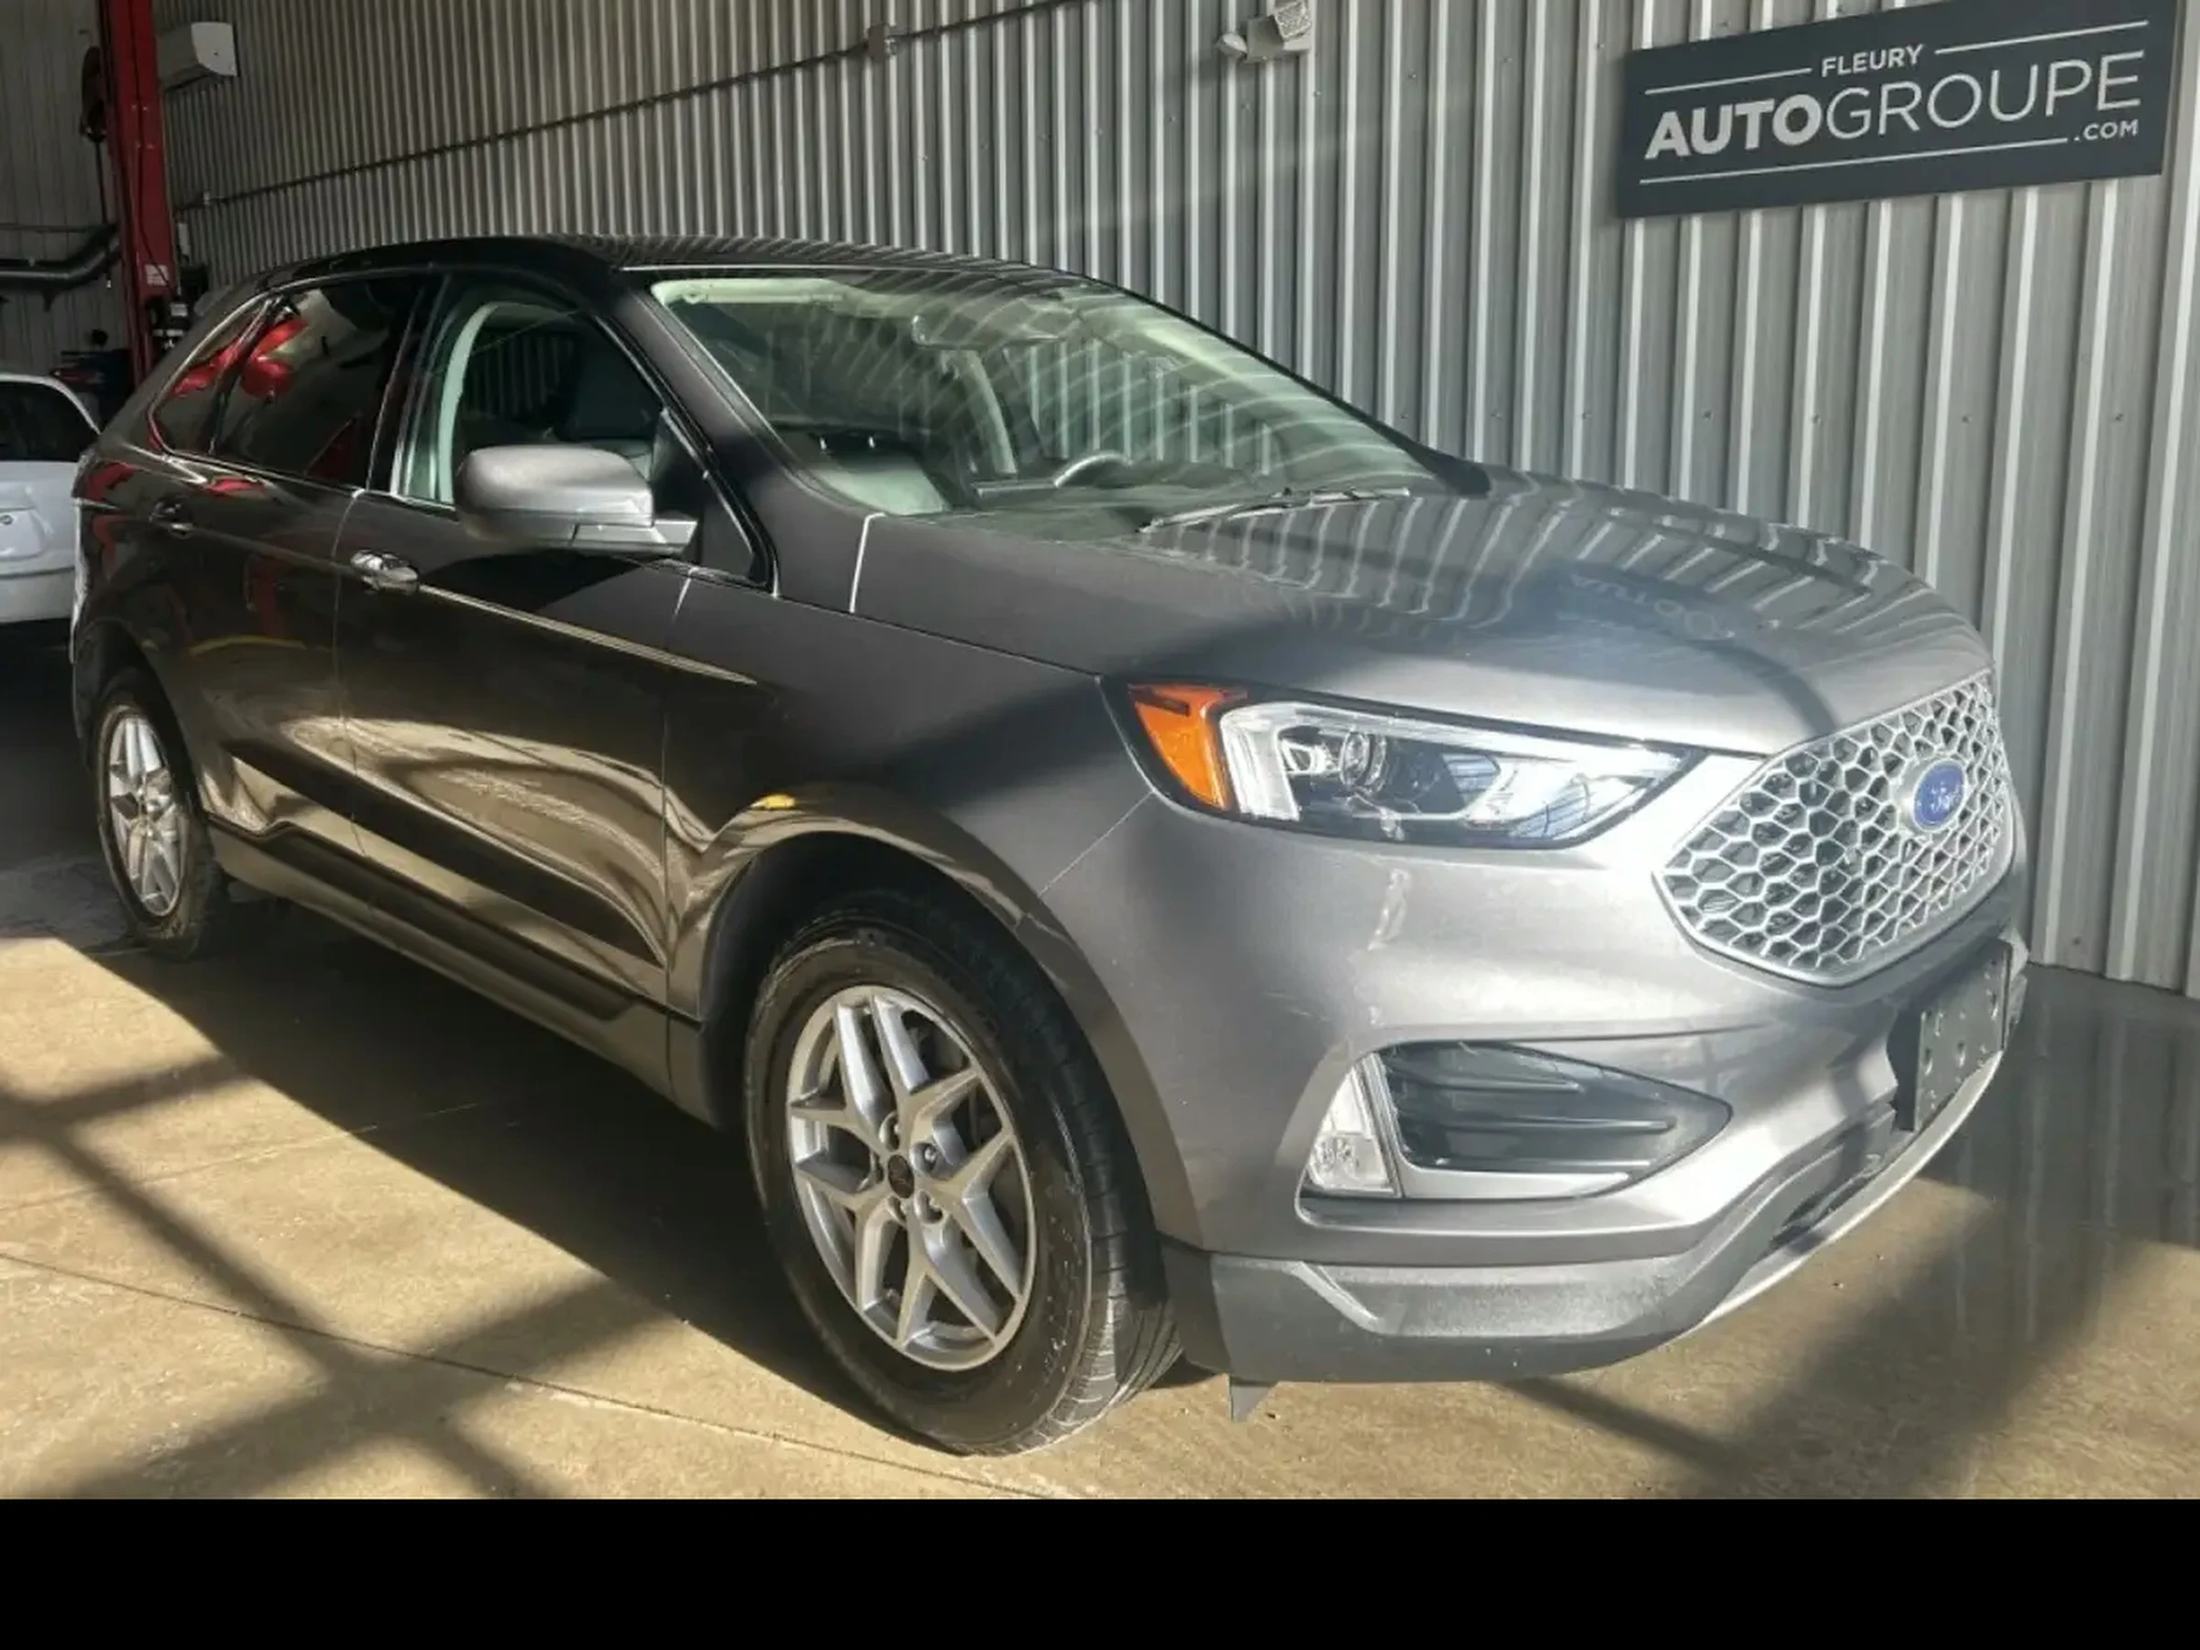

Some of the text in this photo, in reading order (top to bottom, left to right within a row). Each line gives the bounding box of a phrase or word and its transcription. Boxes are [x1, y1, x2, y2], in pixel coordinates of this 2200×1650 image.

[1821, 45, 1924, 78] FLEURY
[1644, 50, 2145, 160] AUTOGROUPE
[2073, 118, 2139, 143] .COM
